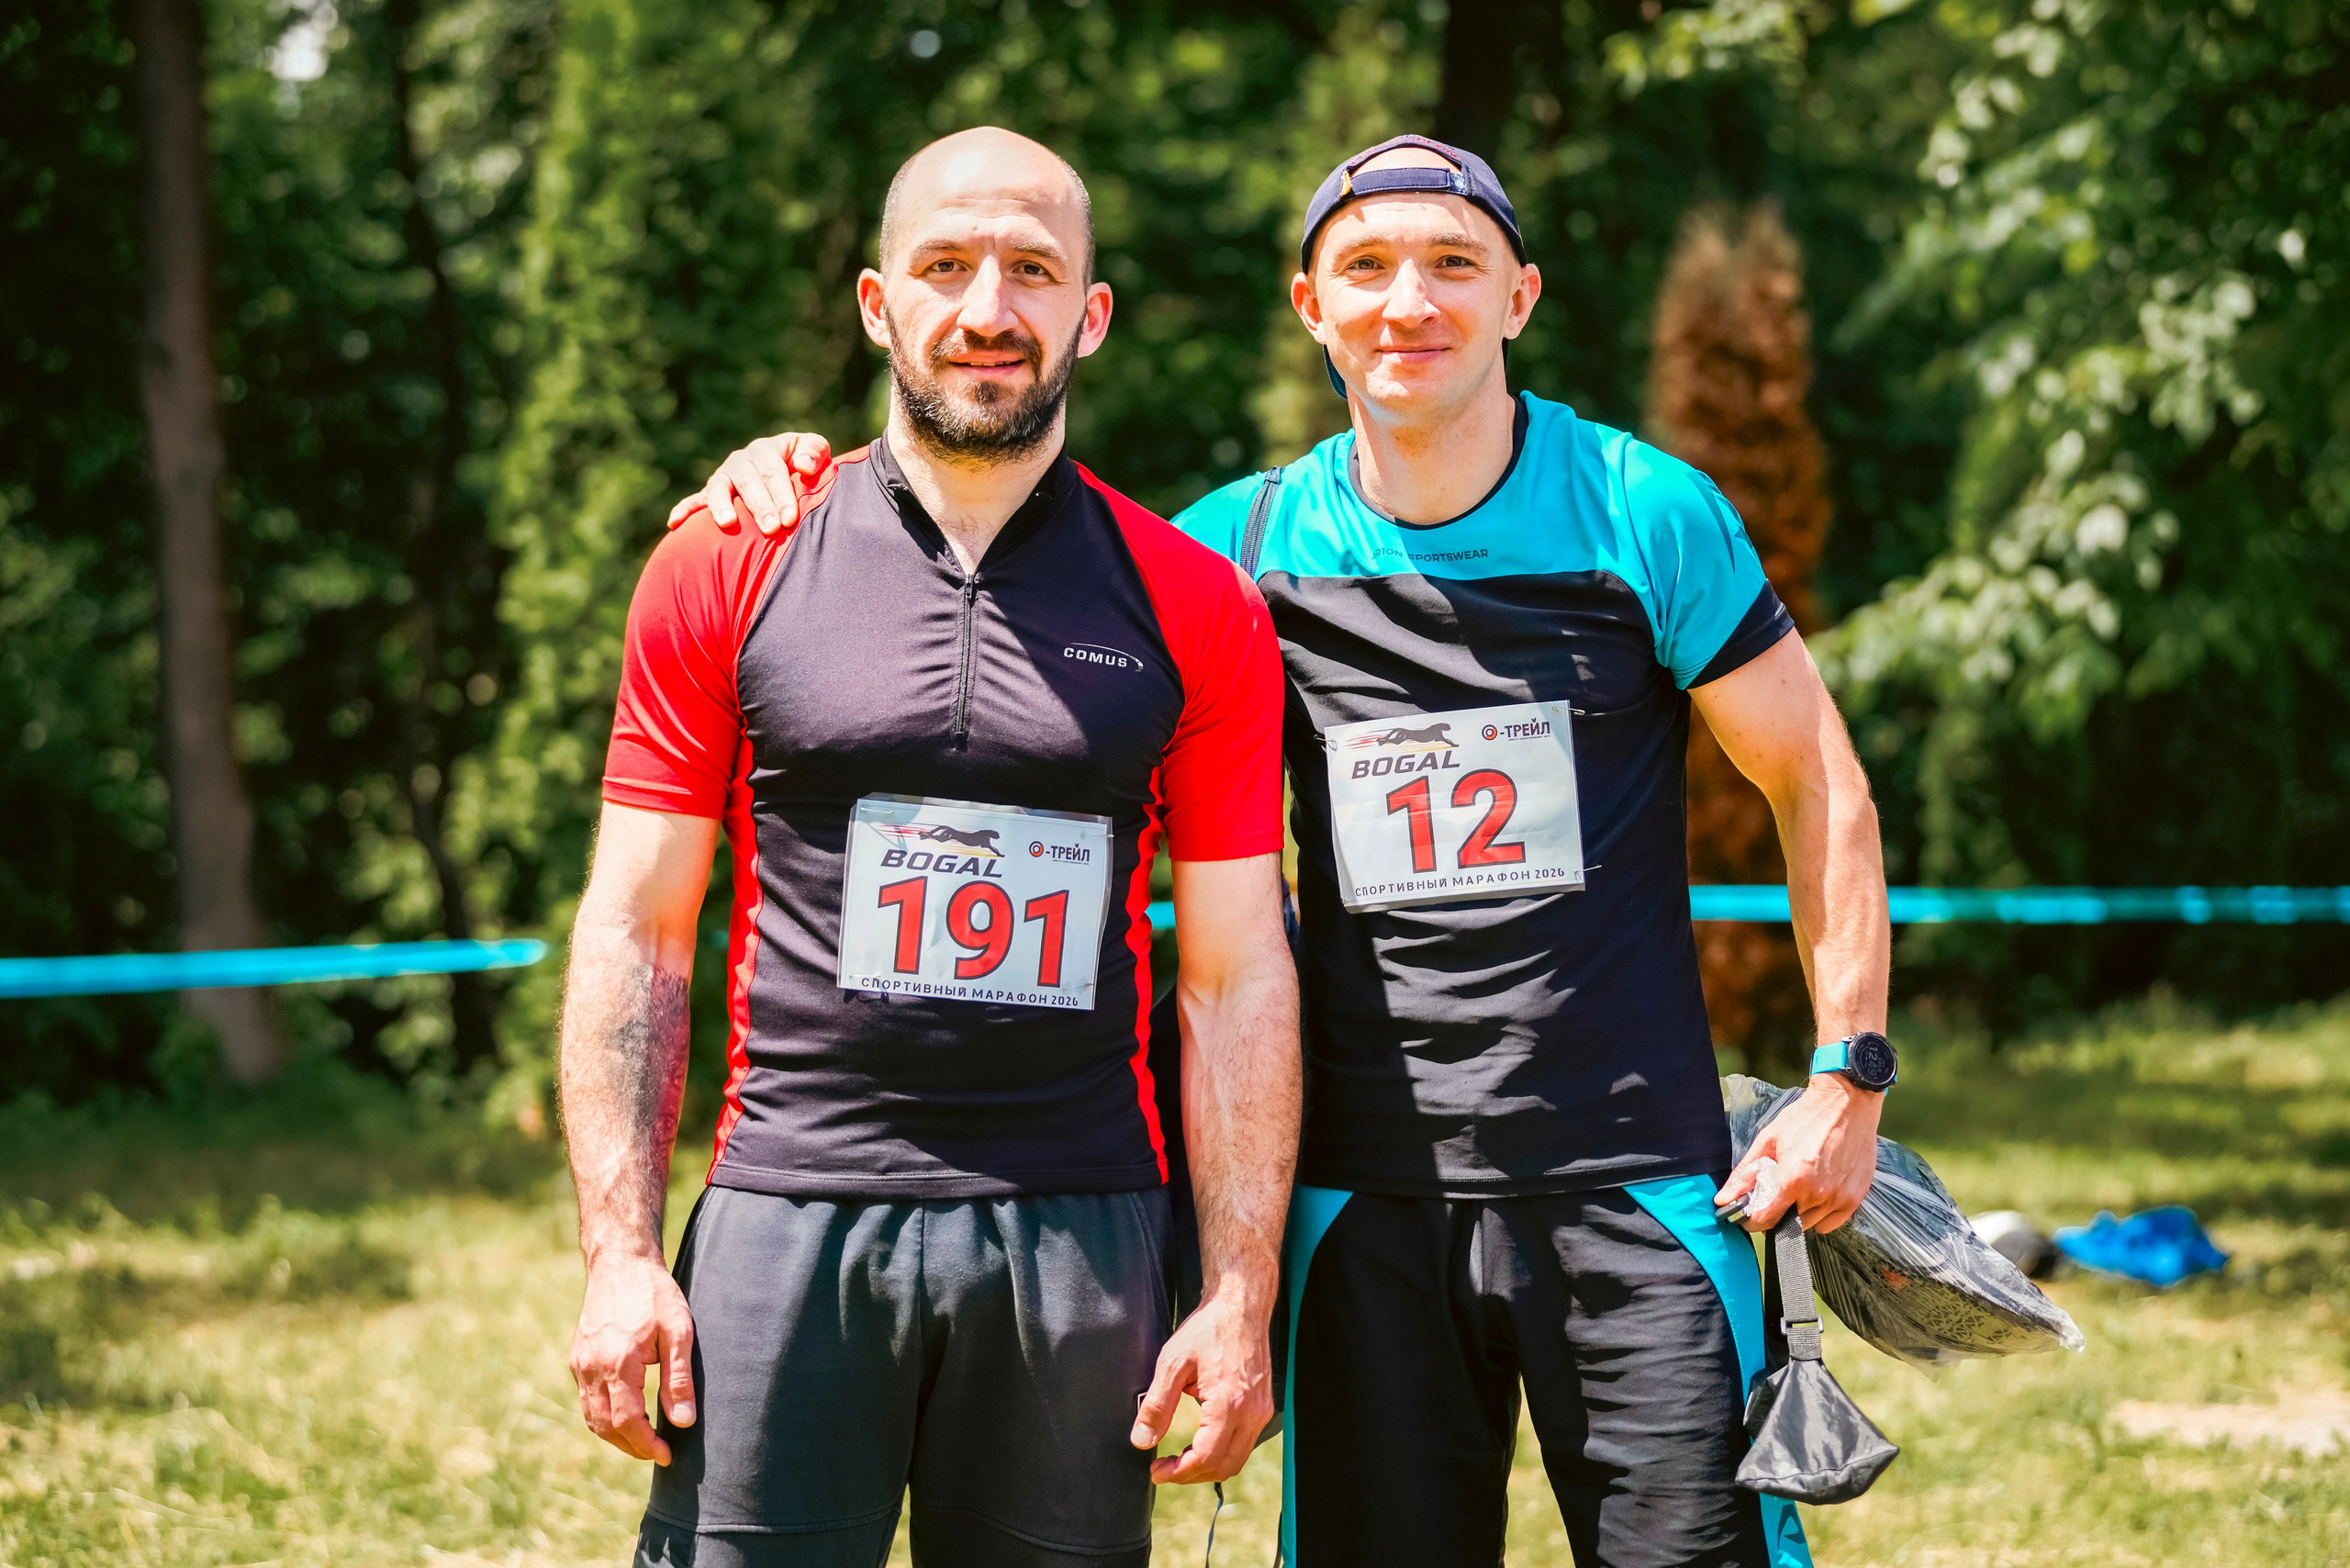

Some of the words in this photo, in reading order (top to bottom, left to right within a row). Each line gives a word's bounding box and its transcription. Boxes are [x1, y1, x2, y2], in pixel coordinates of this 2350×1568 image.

[1408, 549, 1489, 562] SPORTSWEAR
[1063, 646, 1127, 667] COMUS
[1351, 750, 1460, 779] BOGAL
[1385, 768, 1527, 873] 12
[880, 848, 1003, 878] BOGAL
[1355, 878, 1448, 897] СПОРТИВНЫЙ
[1452, 871, 1530, 887] МАРАФОН
[1535, 868, 1565, 879] 2026
[878, 875, 1069, 988] 191
[861, 977, 968, 997] СПОРТИВНЫЙ
[971, 989, 1047, 1004] МАРАФОН
[1051, 995, 1079, 1006] 2026
